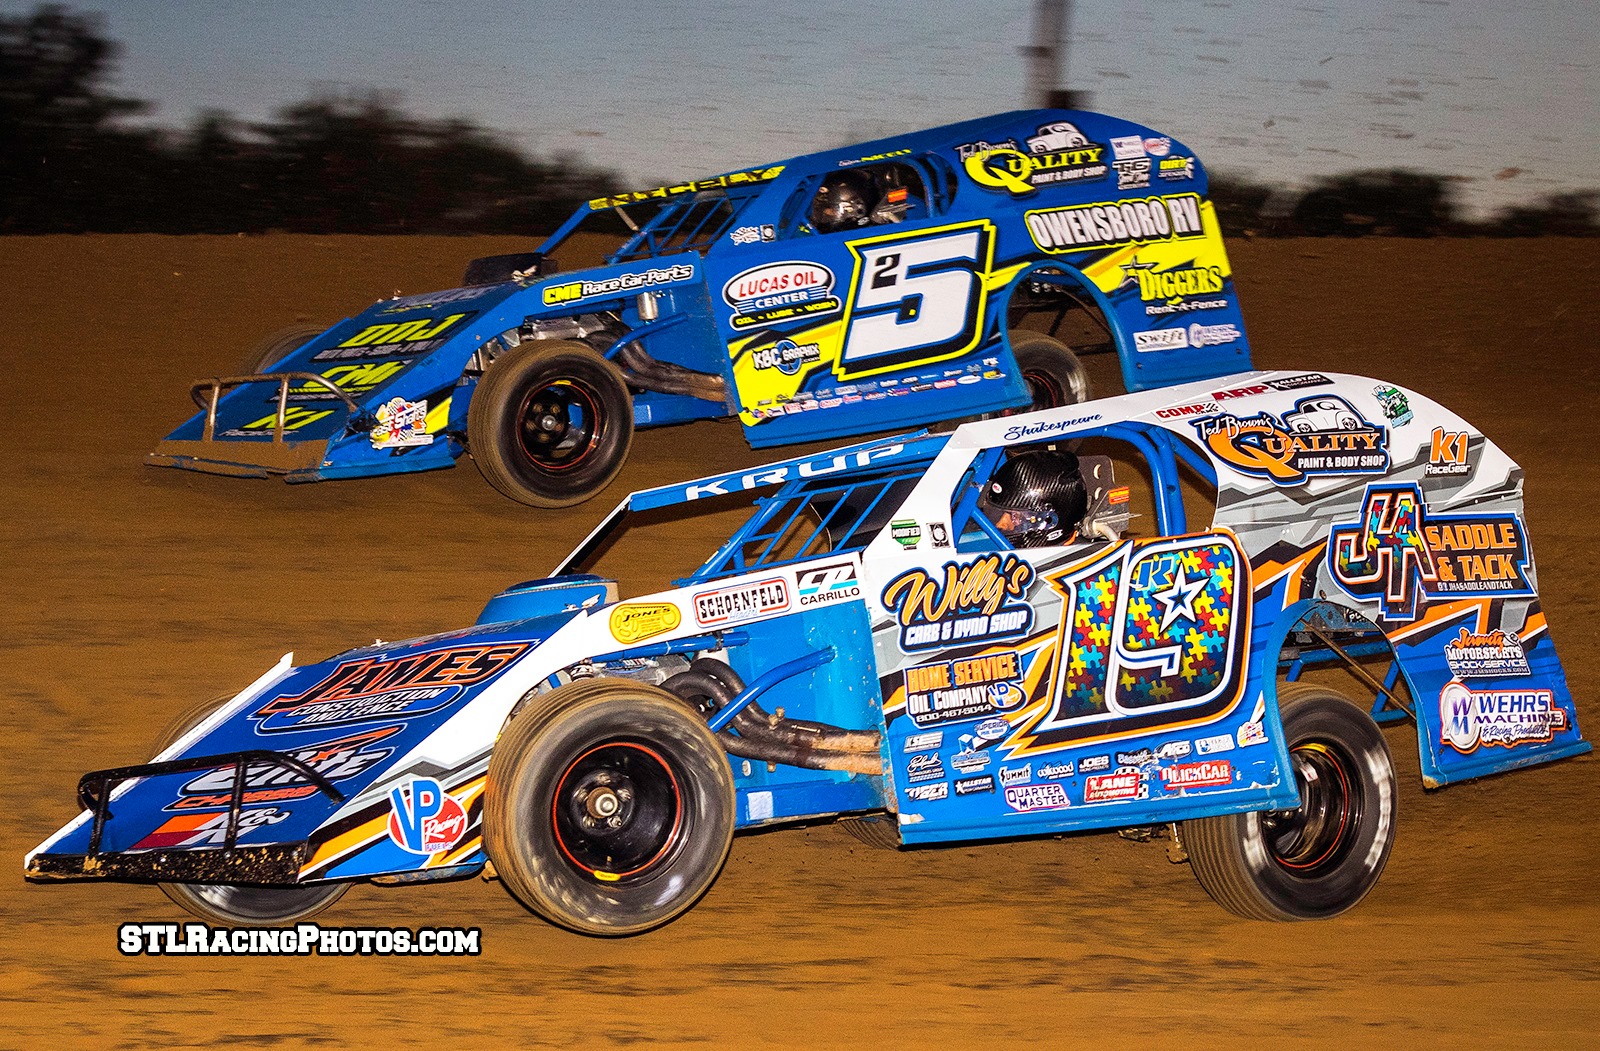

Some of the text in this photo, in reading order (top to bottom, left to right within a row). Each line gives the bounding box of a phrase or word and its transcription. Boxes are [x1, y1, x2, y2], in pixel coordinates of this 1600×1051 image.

[954, 142, 976, 162] Ted
[964, 147, 1104, 193] QUALITY
[1031, 172, 1056, 184] PAINT
[1063, 169, 1083, 180] BODY
[1083, 166, 1107, 178] SHOP
[1028, 197, 1201, 248] OWENSBORO RV
[544, 266, 692, 304] CME Race Car Parts
[739, 271, 818, 298] LUCAS OIL
[1137, 267, 1223, 301] DIGGERS
[755, 291, 809, 309] CENTER
[1211, 385, 1269, 401] ARP
[1156, 403, 1206, 419] COMP
[1004, 413, 1103, 441] Shakespeare
[1194, 415, 1275, 441] Ted Brown's
[1208, 427, 1381, 478] QUALITY
[1297, 454, 1386, 469] PAINT & BODY SHOP
[1425, 464, 1471, 475] RaceGear
[1425, 523, 1518, 551] SADDLE
[1135, 556, 1175, 591] K
[1437, 553, 1518, 582] & TACK
[699, 585, 785, 619] SCHOENFELD
[800, 587, 860, 606] CARRILLO
[884, 556, 1030, 626] Willy's
[622, 608, 671, 623] JONES
[905, 610, 1028, 646] CARB & DYNO SHOP
[1048, 535, 1242, 730] 19
[1446, 646, 1523, 661] MOTORSPORTS
[258, 644, 531, 715] JAMES
[906, 654, 1018, 694] HOME SERVICE
[287, 688, 447, 718] CONSTRUCTION
[297, 700, 417, 725] AND FENCE
[909, 693, 931, 715] OIL
[933, 685, 989, 711] COMPANY
[1479, 694, 1550, 714] WEHRS
[1473, 712, 1562, 724] MACHINE
[1079, 755, 1110, 769] JOES
[1007, 785, 1061, 803] QUARTER
[1089, 775, 1137, 791] LANE
[391, 779, 442, 852] VP
[1018, 794, 1066, 810] MASTER
[425, 814, 465, 843] Racing
[426, 842, 454, 851] FUELS
